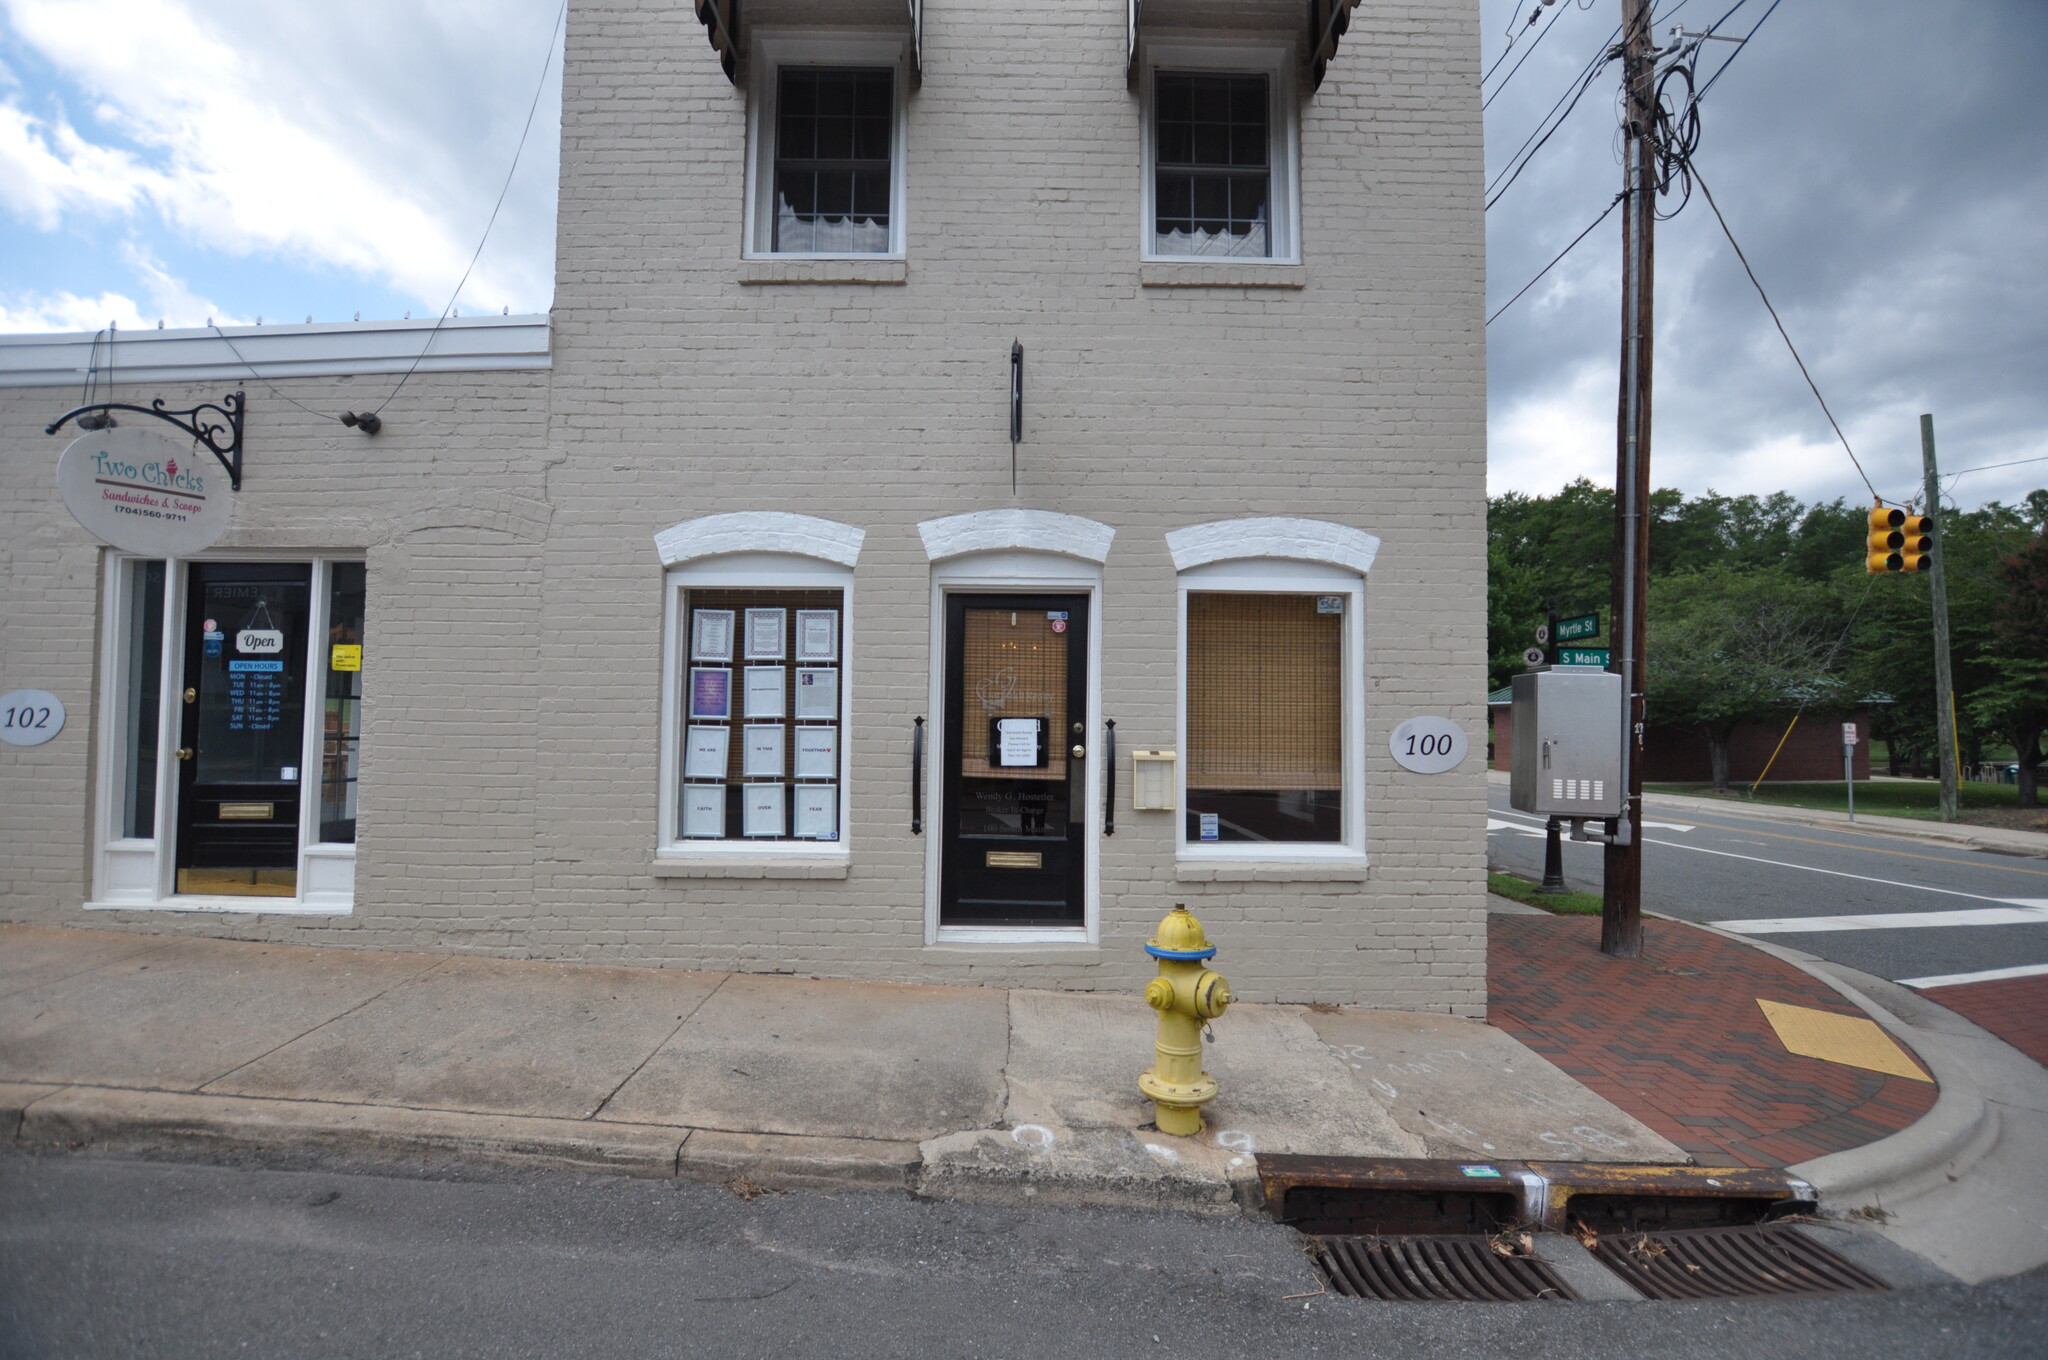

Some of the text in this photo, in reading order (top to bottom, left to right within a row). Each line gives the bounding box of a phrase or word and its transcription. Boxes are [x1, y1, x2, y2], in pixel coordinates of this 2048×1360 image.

[91, 451, 137, 479] Two
[102, 488, 202, 515] Sandwiches & Scoops
[1560, 623, 1582, 638] Myrtle
[1585, 620, 1593, 632] St
[244, 634, 276, 650] Open
[1563, 653, 1570, 663] S
[1575, 653, 1600, 664] Main
[4, 707, 50, 728] 102
[1406, 734, 1452, 755] 100
[975, 792, 1003, 801] Wendy
